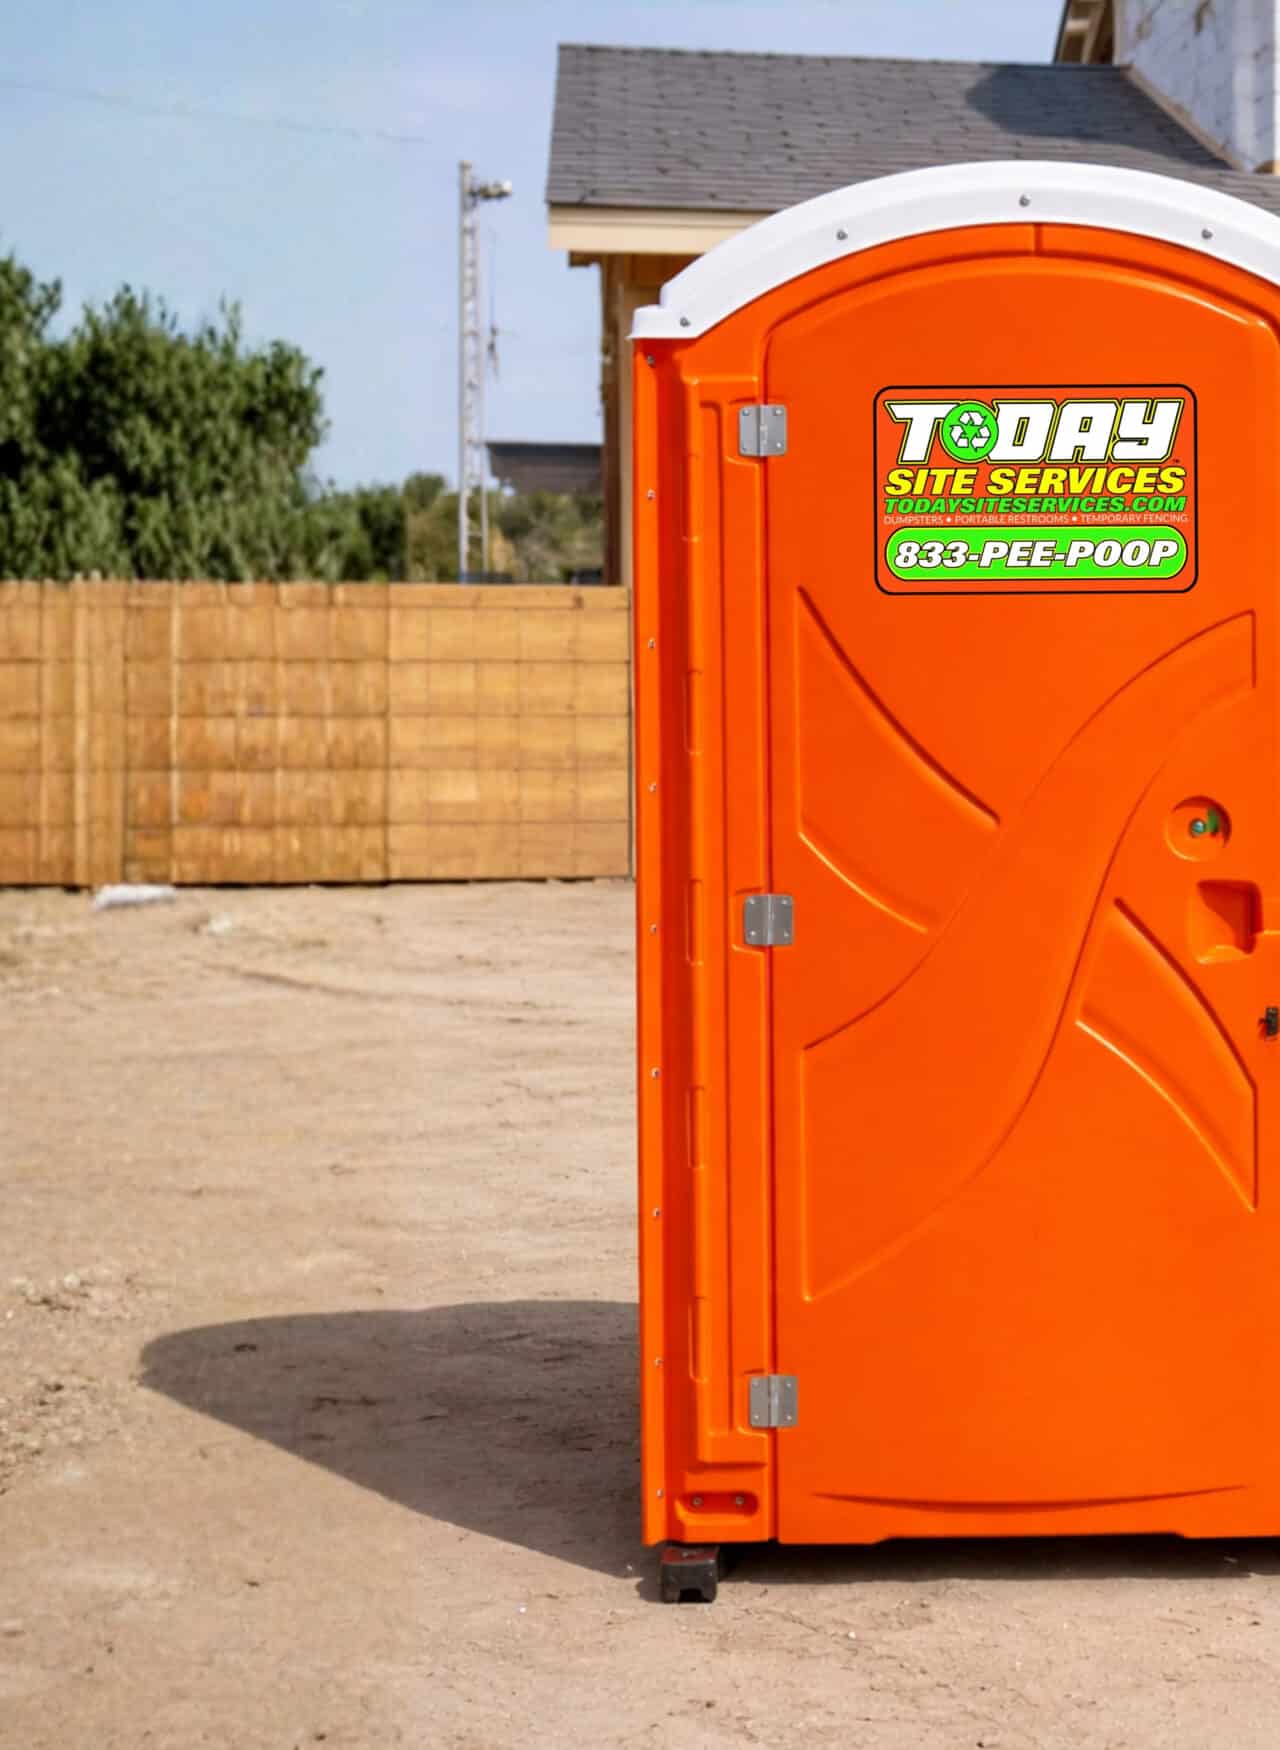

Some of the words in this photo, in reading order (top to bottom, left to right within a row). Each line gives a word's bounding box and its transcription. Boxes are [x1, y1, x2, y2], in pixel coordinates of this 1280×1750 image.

[885, 398, 1184, 464] TODAY
[884, 467, 978, 495] SITE
[986, 466, 1187, 494] SERVICES
[883, 515, 944, 525] DUMPSTERS
[955, 515, 1007, 524] PORTABLE
[1008, 514, 1069, 524] RESTROOMS
[1081, 514, 1141, 523] TEMPORARY
[1143, 514, 1188, 523] FENCING
[884, 496, 1187, 514] TODAYSITESERVICES.COM
[894, 539, 1179, 568] 833-PEE-POOP
